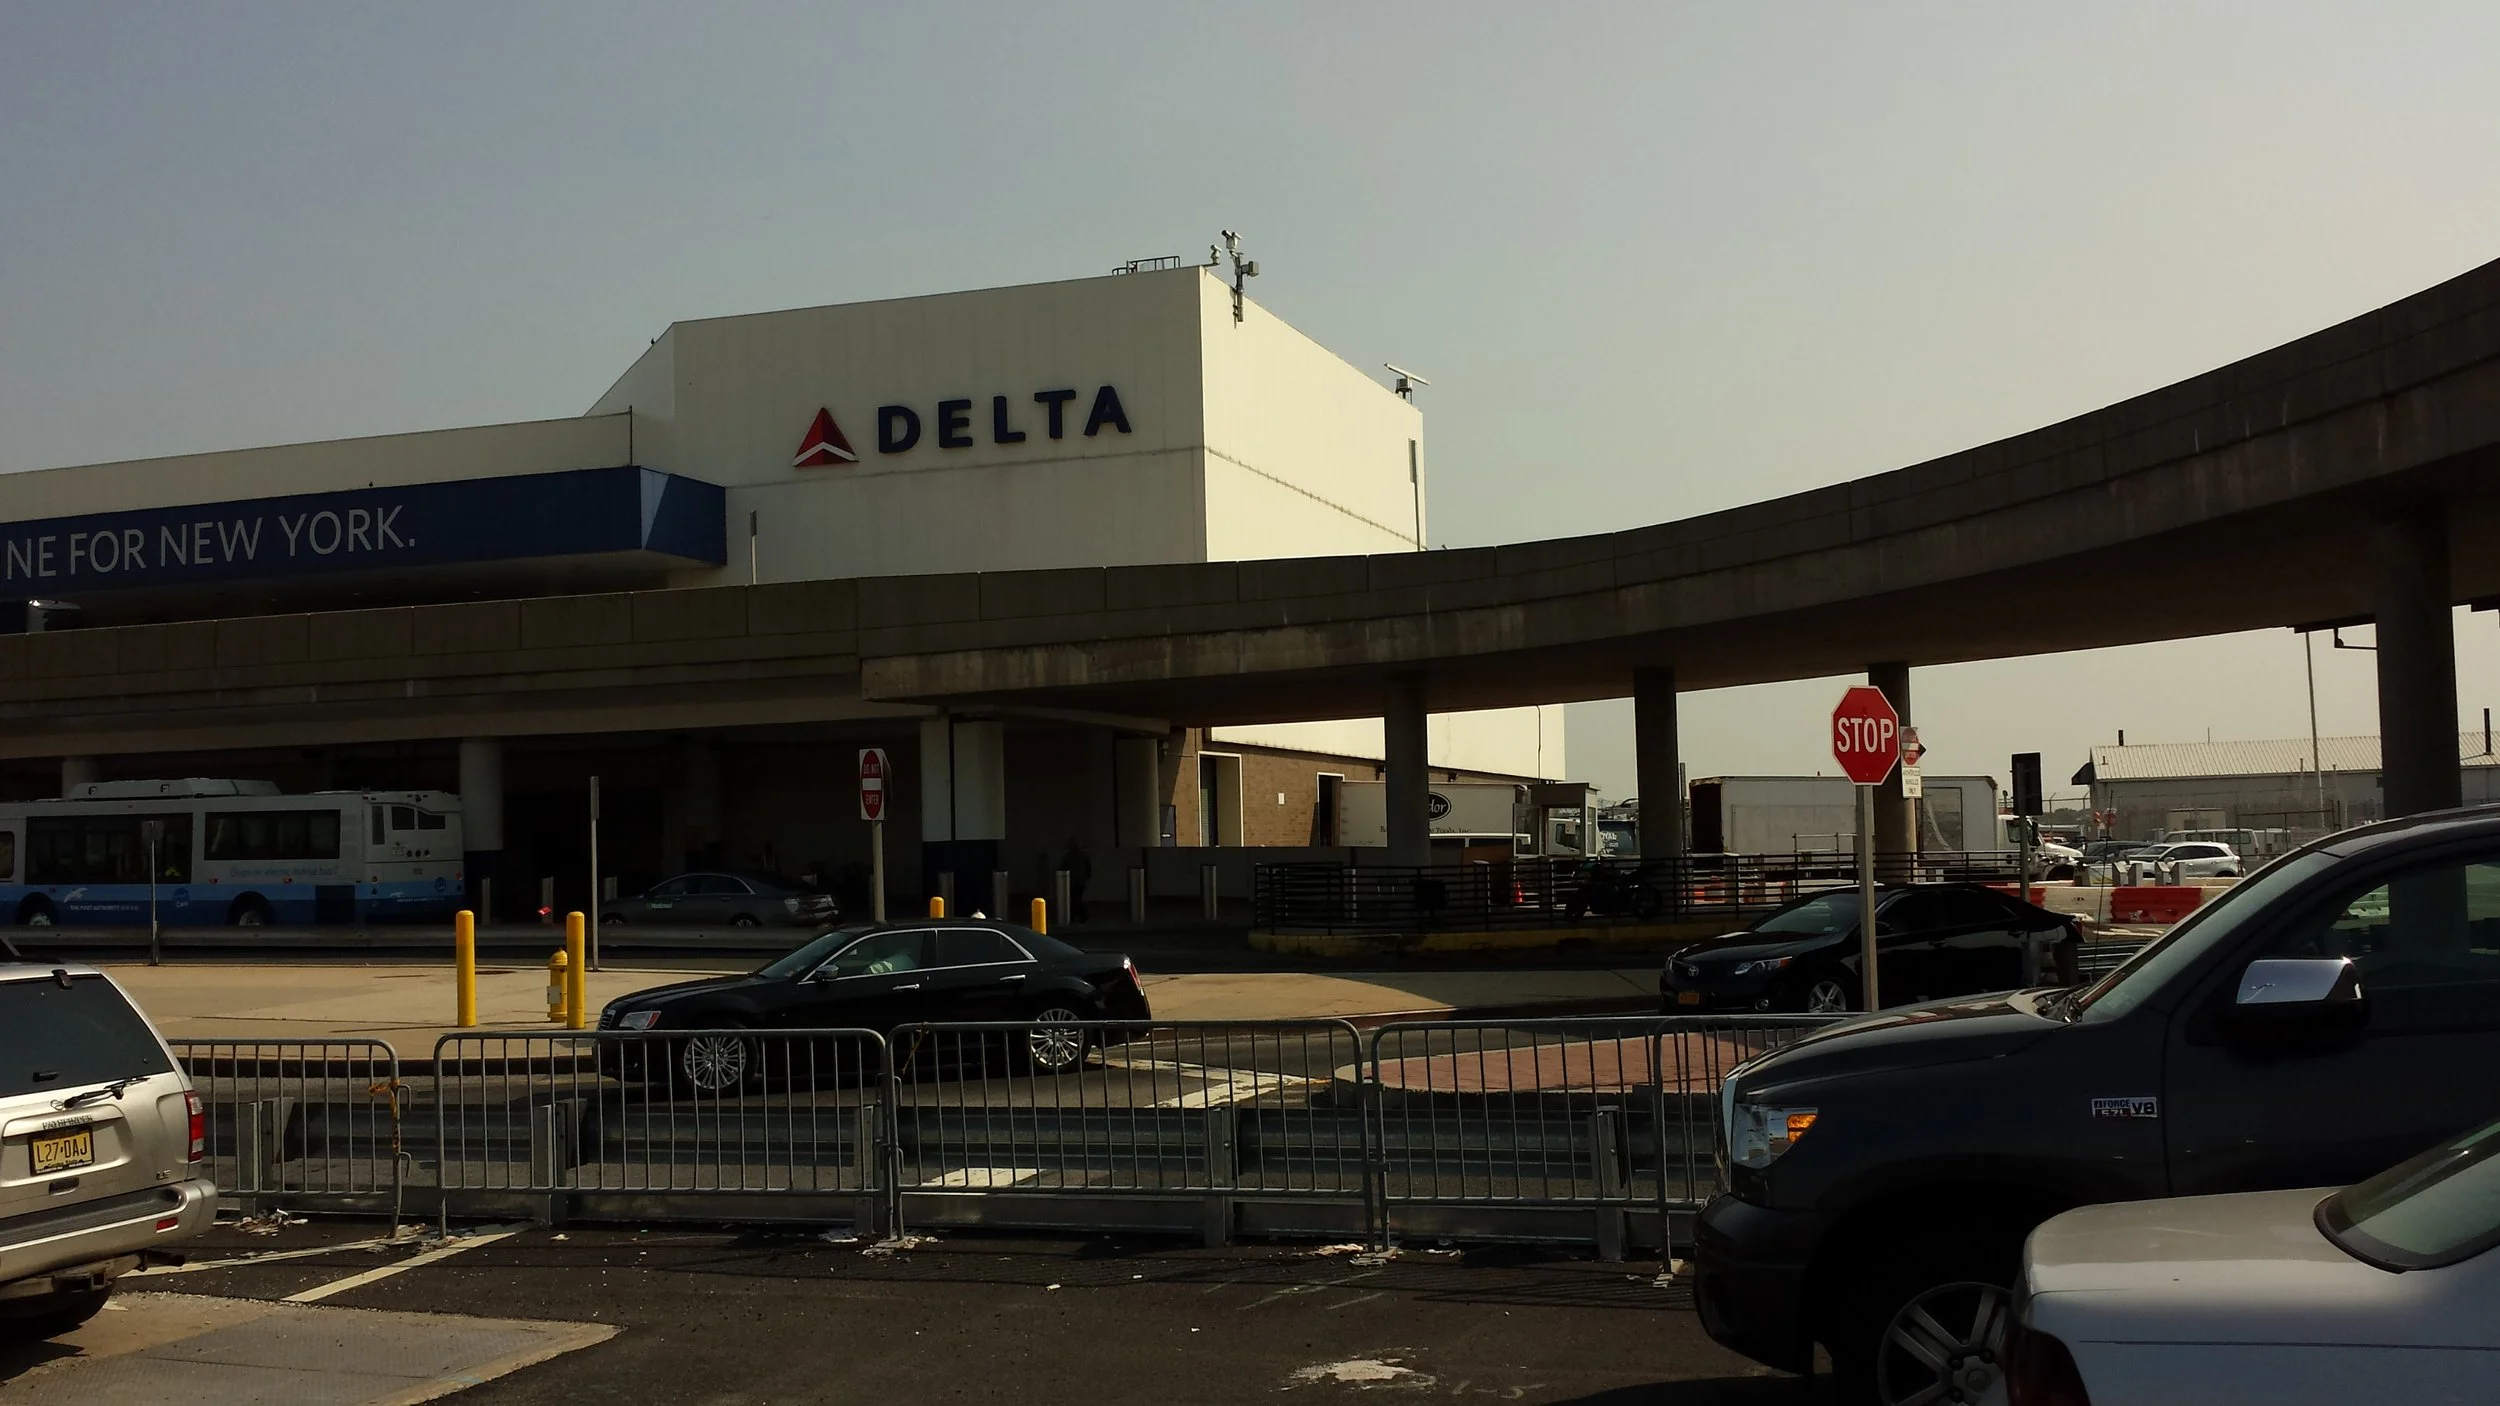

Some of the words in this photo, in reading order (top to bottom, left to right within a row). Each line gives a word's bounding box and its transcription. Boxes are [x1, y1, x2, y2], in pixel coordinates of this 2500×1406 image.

[877, 385, 1133, 454] DELTA
[69, 528, 147, 576] FOR
[159, 516, 264, 568] NEW
[278, 504, 417, 558] YORK.
[1836, 717, 1895, 754] STOP
[2131, 1101, 2155, 1115] V8
